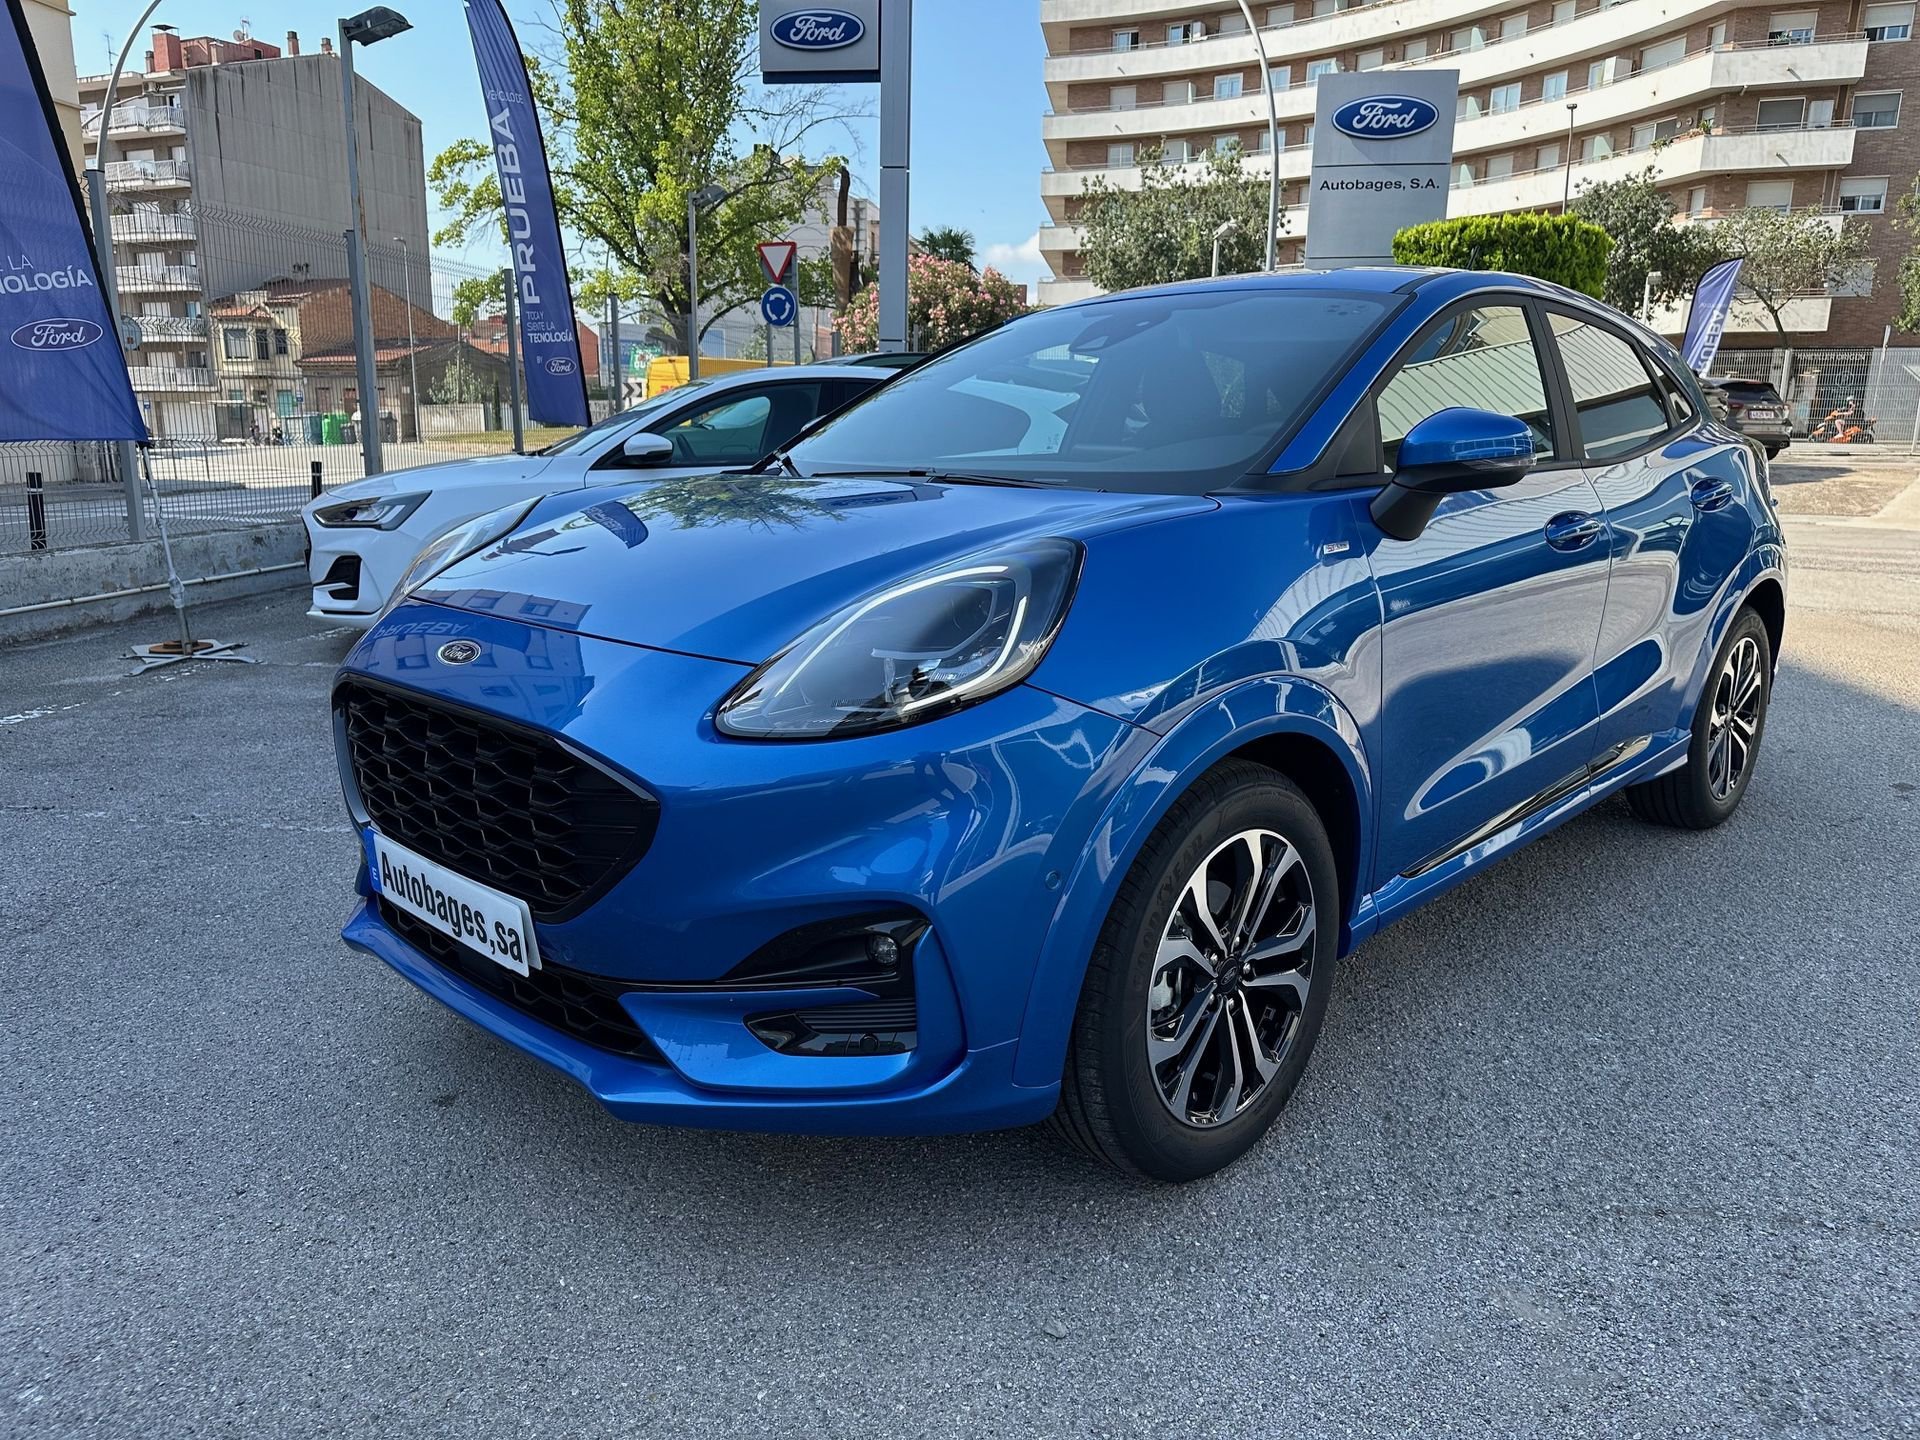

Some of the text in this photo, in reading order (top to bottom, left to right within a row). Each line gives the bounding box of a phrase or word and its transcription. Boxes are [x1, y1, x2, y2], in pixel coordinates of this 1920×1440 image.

[789, 15, 847, 42] Ford
[1352, 101, 1418, 129] Ford
[1319, 178, 1440, 192] Autobages, S.A.
[490, 107, 541, 304] PRUEBA
[7, 254, 34, 271] LA
[31, 322, 86, 347] Ford
[546, 321, 556, 331] LA
[527, 328, 574, 343] TECNOLOGÍA
[550, 359, 571, 372] Ford
[444, 643, 472, 660] Ford
[372, 851, 524, 965] E Autobages,sa
